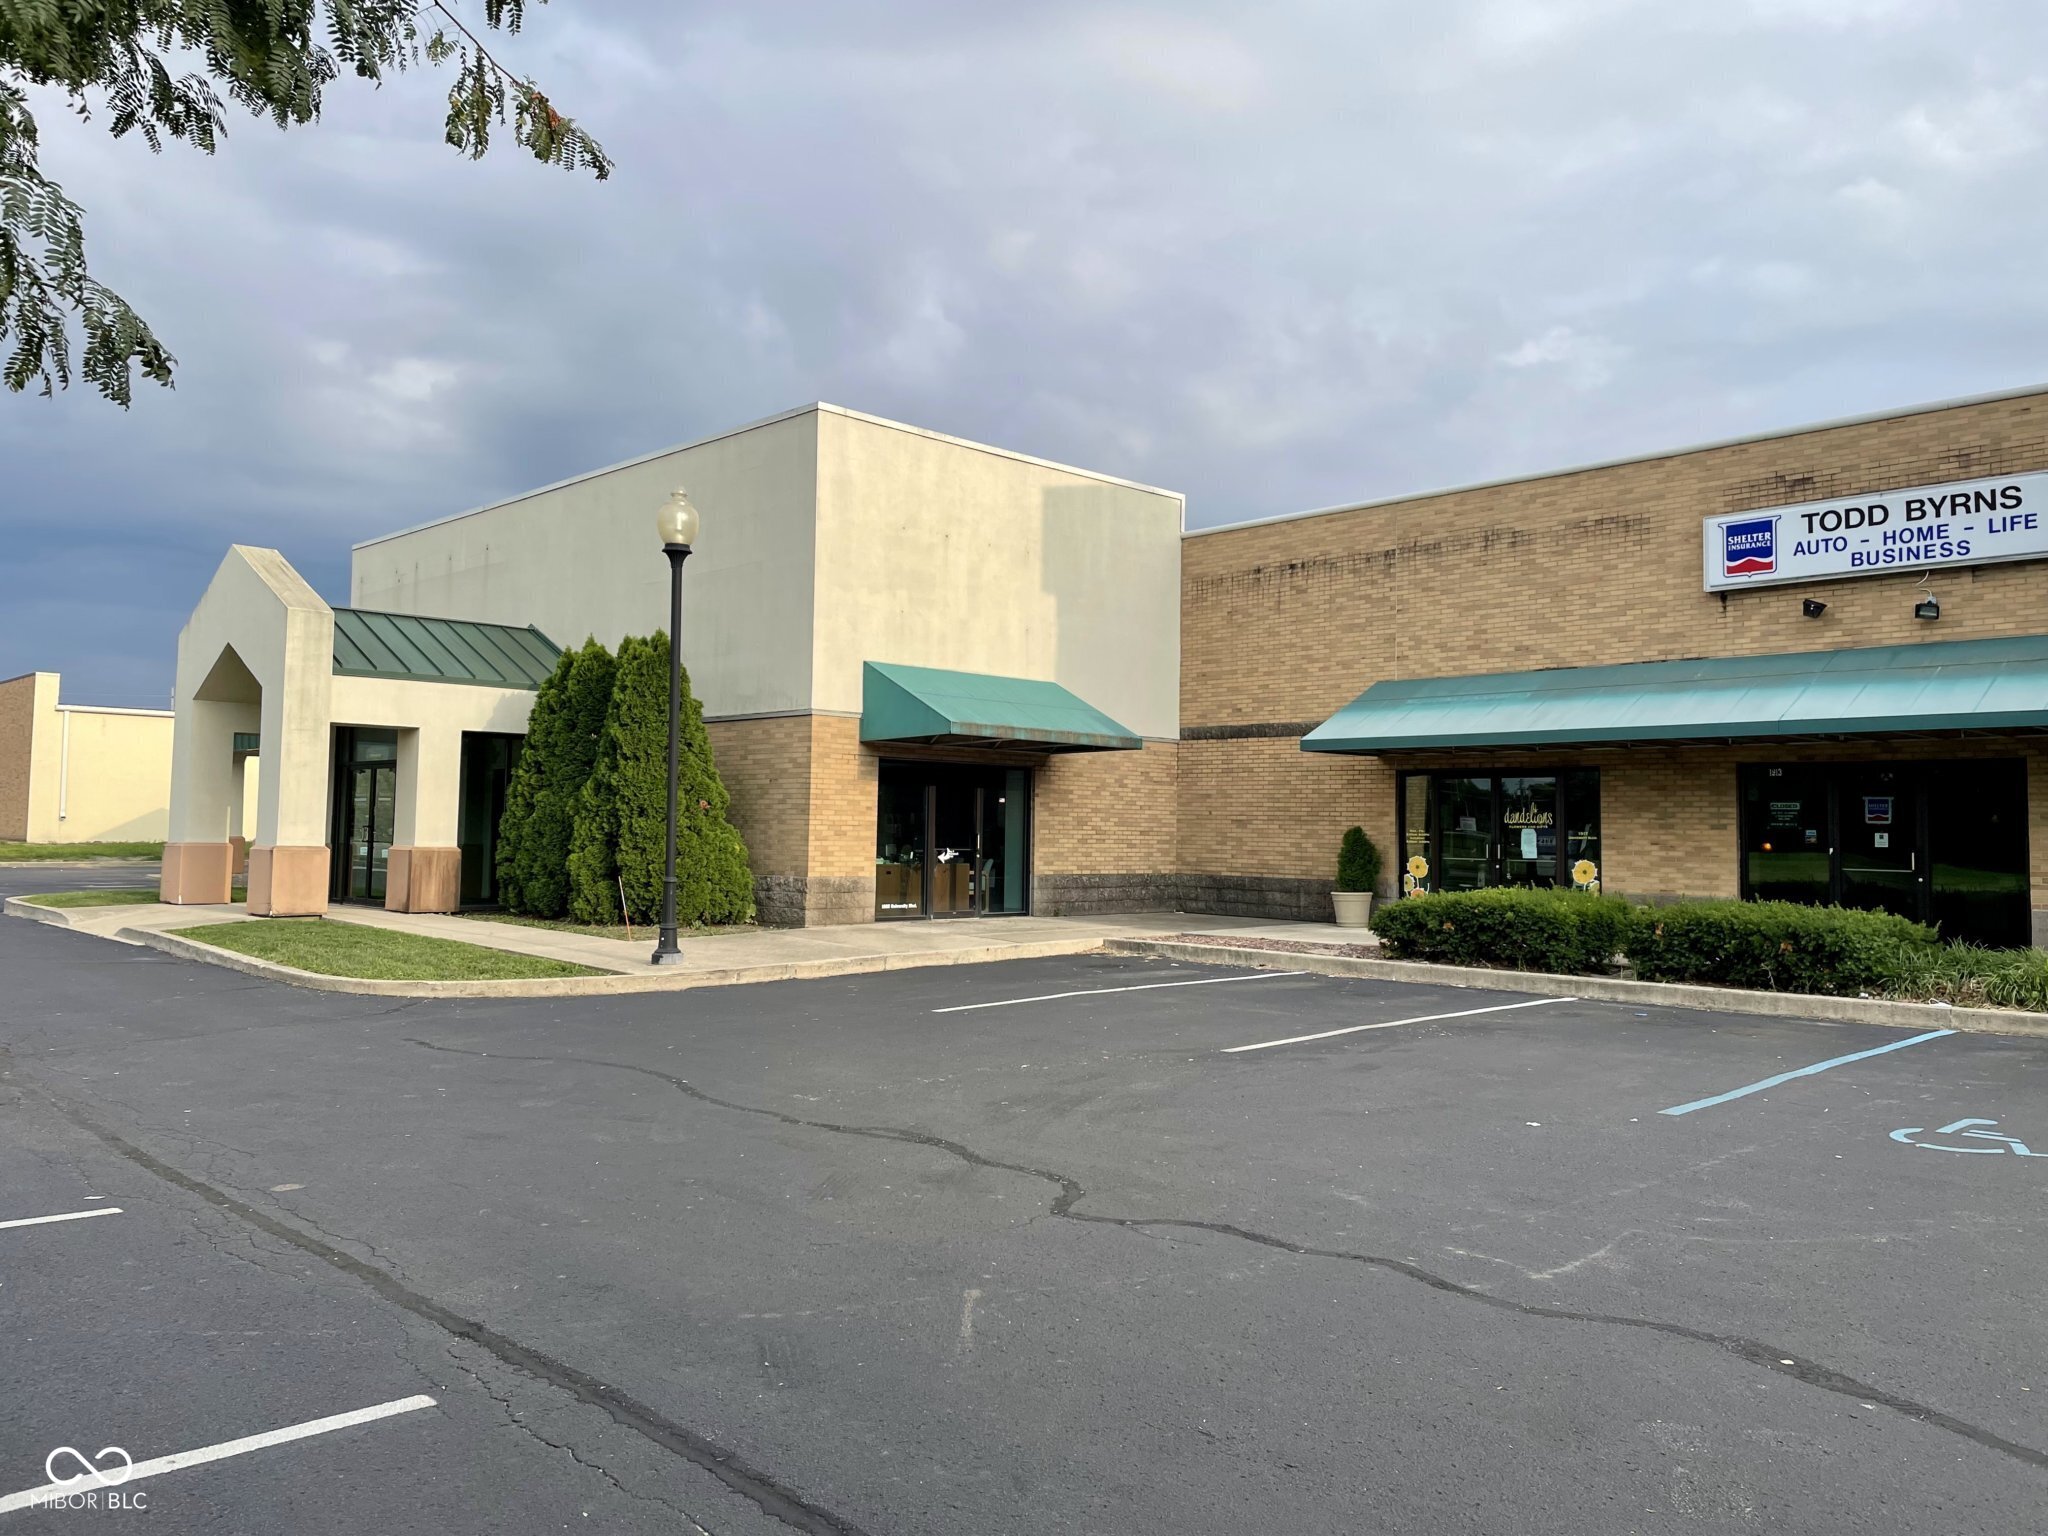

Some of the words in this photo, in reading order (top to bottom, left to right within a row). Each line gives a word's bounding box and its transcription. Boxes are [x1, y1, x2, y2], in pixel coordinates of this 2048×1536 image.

[1800, 504, 1889, 534] TODD
[1905, 485, 2023, 522] BYRNS
[1727, 531, 1772, 545] SHELTER
[1728, 540, 1772, 551] INSURANCE
[1793, 536, 1848, 556] AUTO
[1883, 523, 1950, 546] HOME
[1988, 513, 2038, 534] LIFE
[1851, 540, 1971, 567] BUSINESS
[1504, 802, 1553, 826] dandelions
